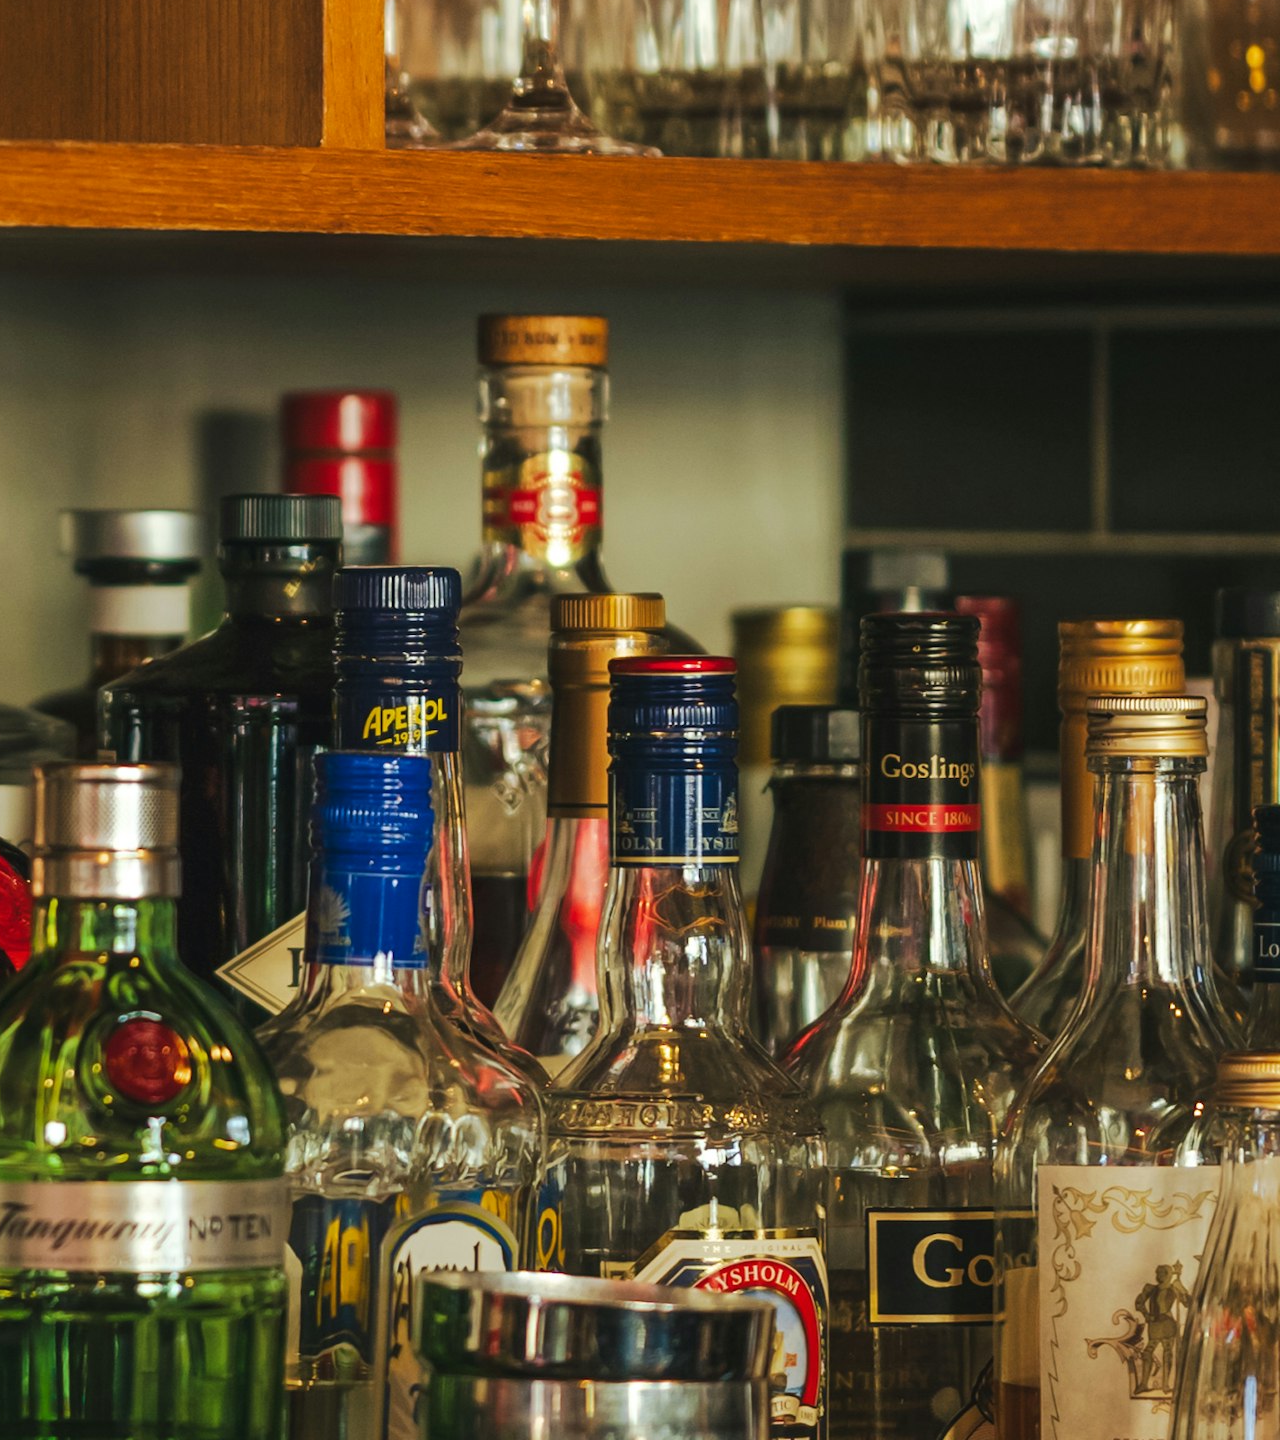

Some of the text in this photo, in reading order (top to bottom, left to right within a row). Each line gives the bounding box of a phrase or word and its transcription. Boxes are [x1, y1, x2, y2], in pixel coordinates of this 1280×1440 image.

[362, 697, 448, 739] APEROL
[881, 753, 975, 787] Goslings
[886, 811, 972, 826] SINCE 1806
[621, 837, 663, 851] OLM
[814, 916, 847, 930] Plum
[1259, 934, 1280, 958] Lo
[231, 1214, 272, 1241] TEN
[703, 1245, 731, 1253] THE
[772, 1401, 791, 1413] TIC
